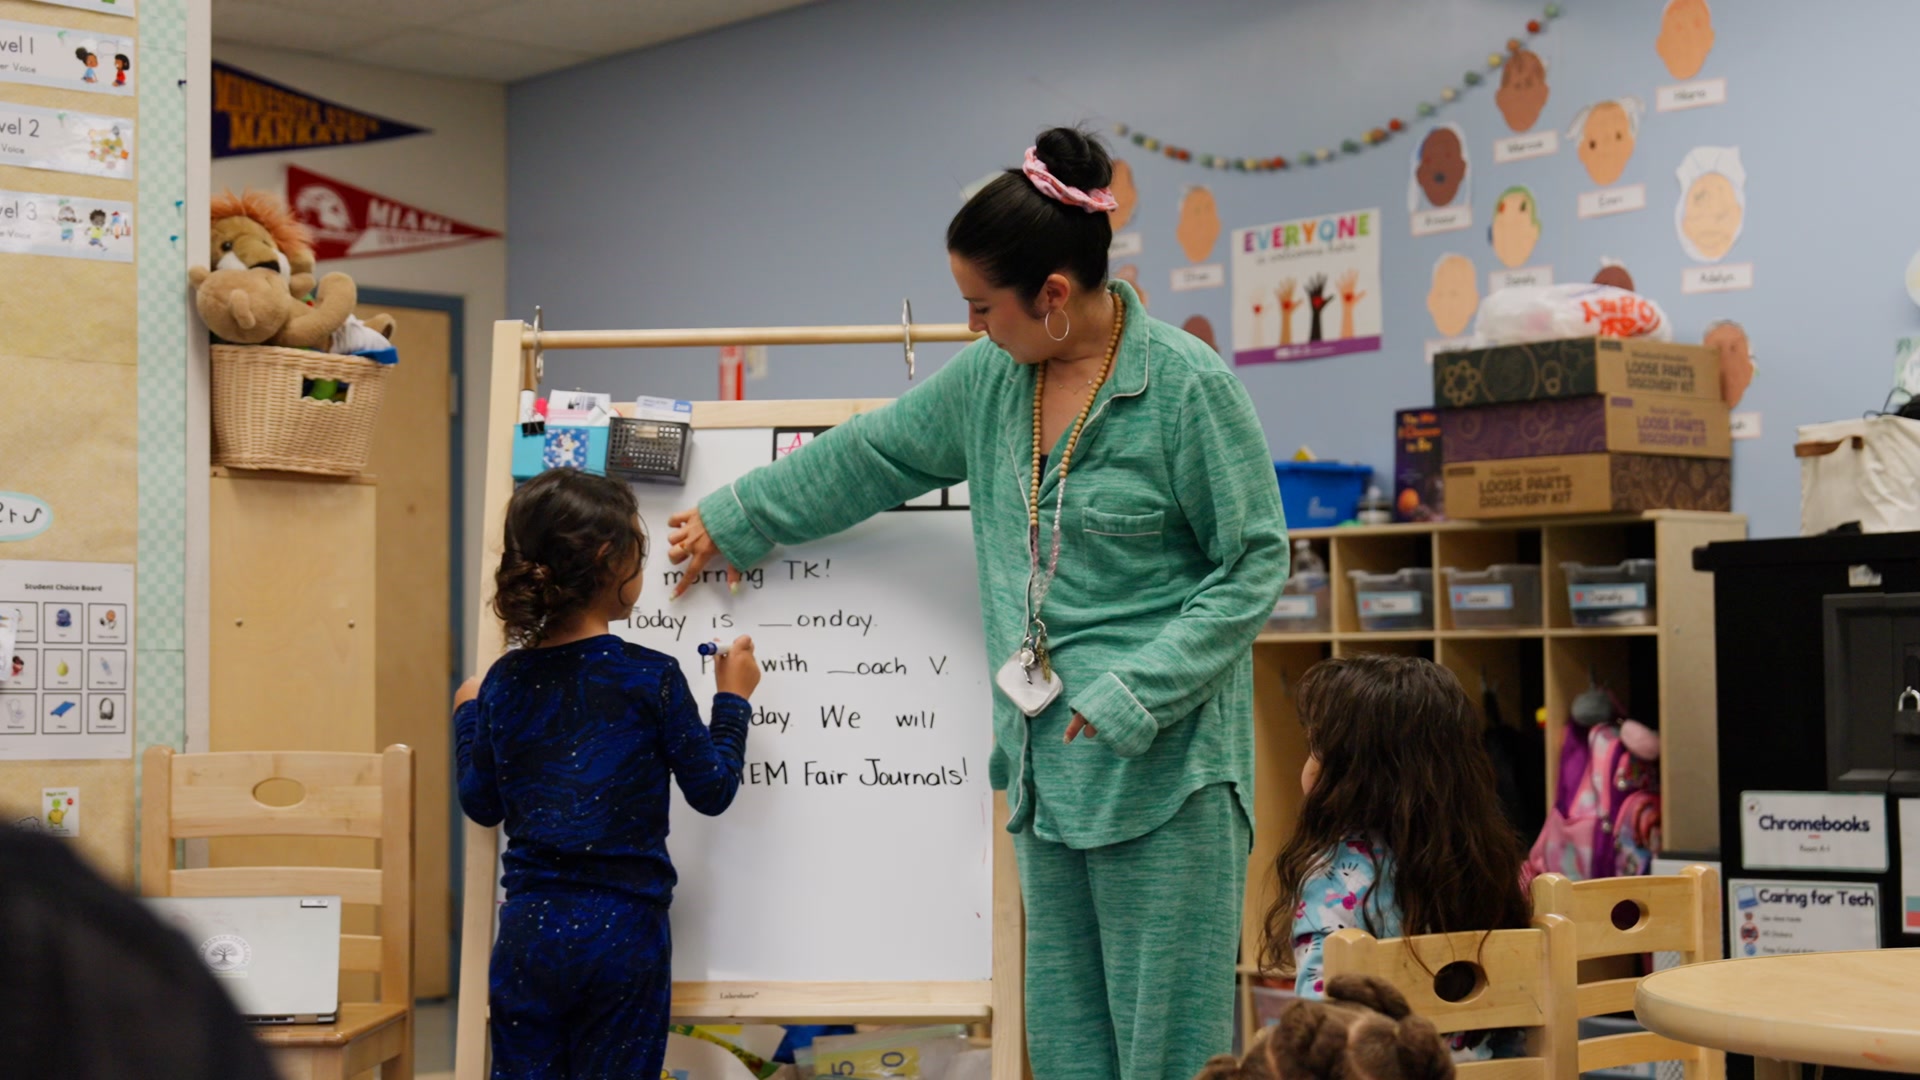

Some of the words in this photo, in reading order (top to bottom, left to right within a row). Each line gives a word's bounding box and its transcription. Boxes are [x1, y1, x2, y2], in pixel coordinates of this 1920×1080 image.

[29, 118, 40, 138] 2
[25, 201, 38, 221] 3
[1243, 212, 1370, 252] EVERYONE
[1479, 476, 1523, 494] LOOSE
[1527, 474, 1572, 490] PARTS
[1551, 490, 1572, 504] KIT
[783, 559, 832, 581] TK!
[24, 583, 54, 591] Student
[81, 584, 103, 592] Board
[712, 612, 734, 629] is
[761, 653, 809, 674] with
[820, 705, 861, 729] We
[896, 710, 936, 729] will
[804, 760, 849, 786] Fair
[860, 757, 970, 787] Journals!
[1758, 814, 1871, 832] Chromebooks
[1759, 888, 1808, 908] Caring
[1811, 888, 1834, 905] for
[1836, 890, 1874, 906] Tech
